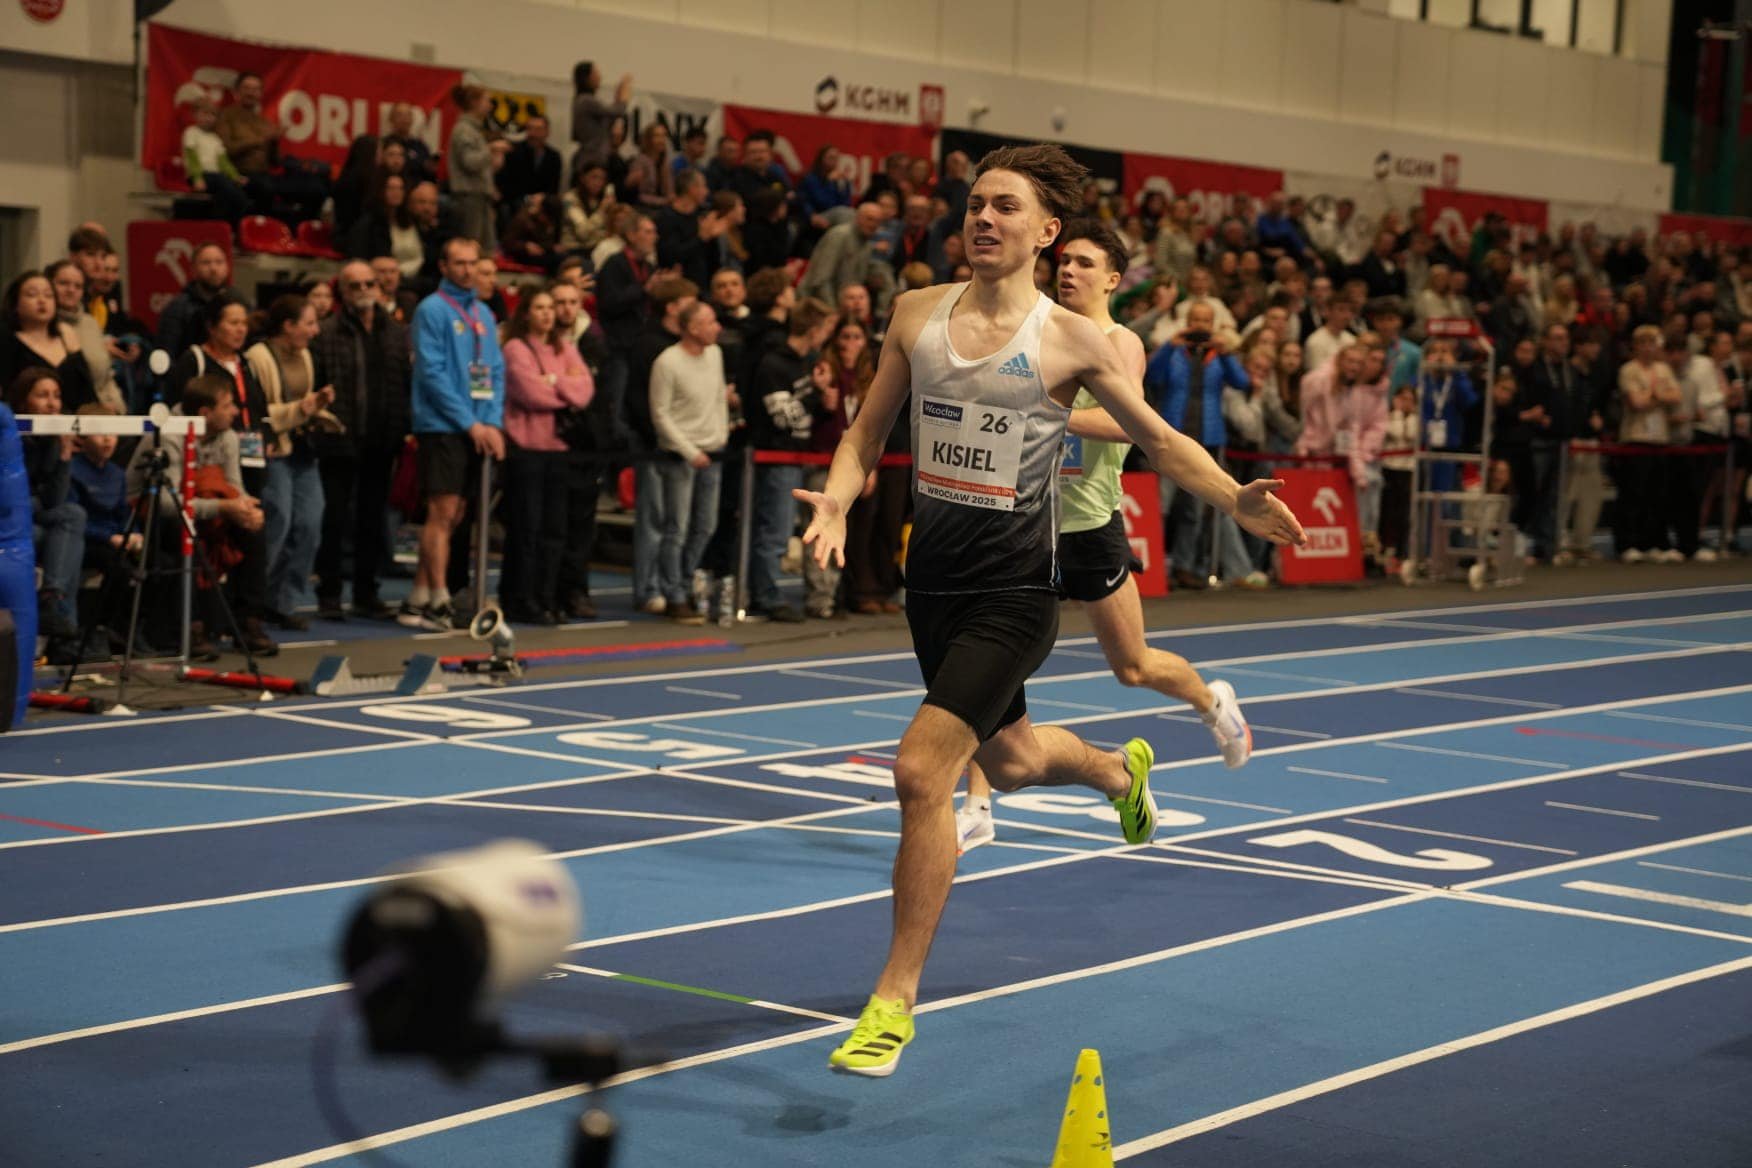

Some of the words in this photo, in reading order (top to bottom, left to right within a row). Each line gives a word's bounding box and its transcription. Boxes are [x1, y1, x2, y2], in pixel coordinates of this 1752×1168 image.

[998, 366, 1034, 379] adidas
[980, 413, 1009, 434] 26
[932, 440, 996, 472] KISIEL
[971, 495, 997, 506] 2025
[1245, 829, 1495, 871] 2
